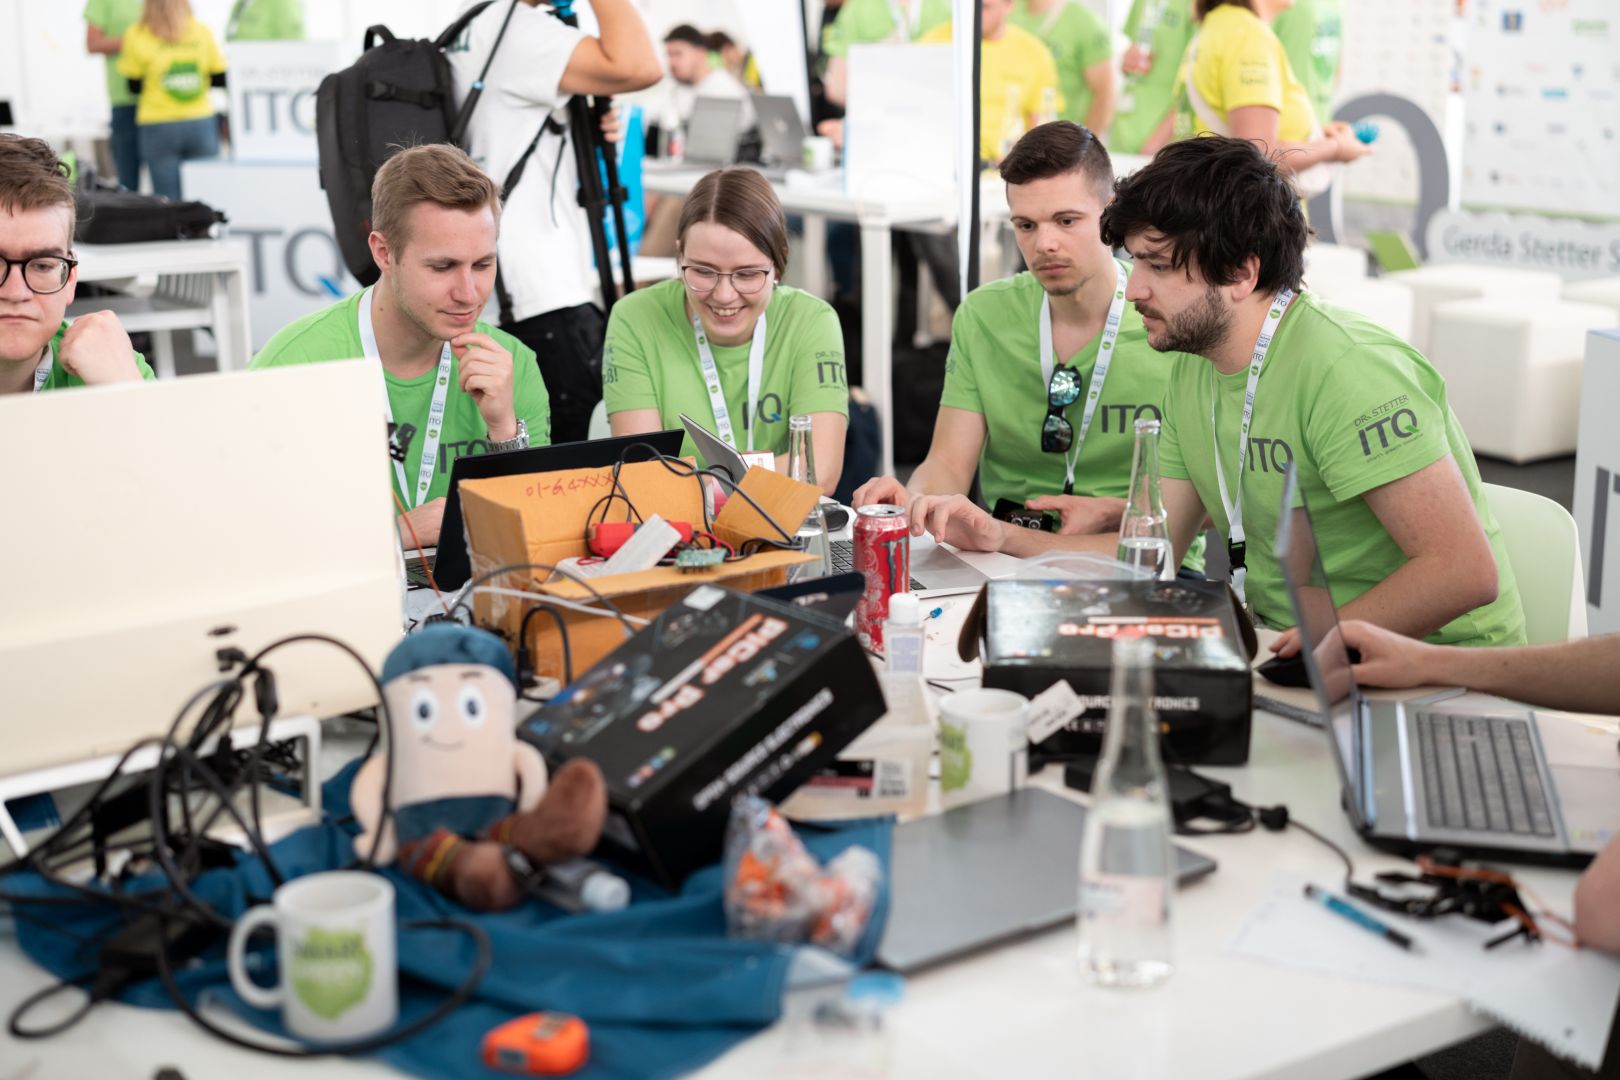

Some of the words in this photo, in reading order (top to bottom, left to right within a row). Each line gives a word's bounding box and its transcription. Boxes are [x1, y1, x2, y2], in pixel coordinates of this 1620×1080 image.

[224, 227, 346, 297] TQ
[1443, 223, 1513, 261] Gerda
[1518, 230, 1602, 269] Stetter
[741, 392, 783, 430] IQ
[1372, 394, 1409, 417] STETTER
[1359, 408, 1419, 456] ITQ
[1248, 437, 1295, 475] ITQ
[637, 684, 703, 732] Pro
